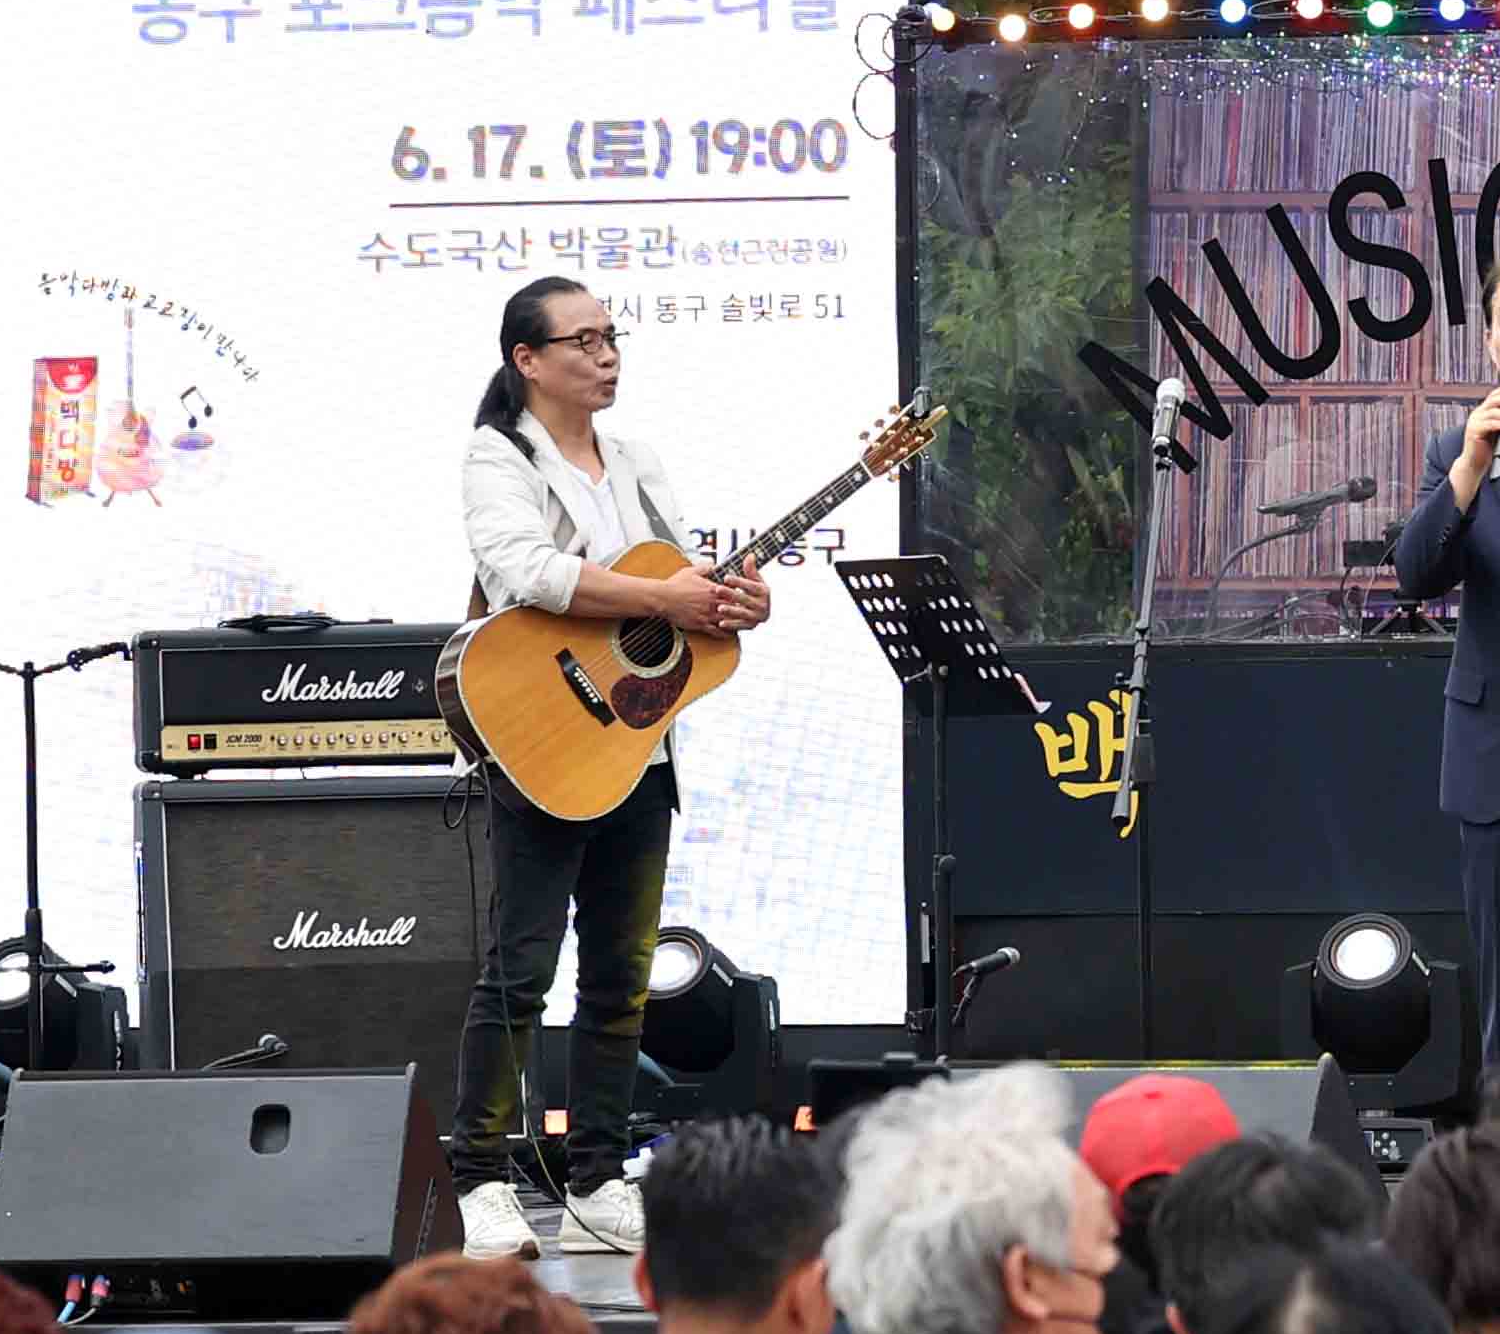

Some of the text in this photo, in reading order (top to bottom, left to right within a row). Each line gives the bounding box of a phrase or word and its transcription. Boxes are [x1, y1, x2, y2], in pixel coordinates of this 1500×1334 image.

[391, 117, 849, 183] 6. 17. (토) 19:00
[357, 226, 533, 273] 수도국산
[655, 296, 707, 324] 동구
[720, 294, 804, 323] 솔빛로
[813, 293, 846, 320] 51
[261, 663, 406, 703] Marshall
[1034, 689, 1140, 838] 백
[273, 910, 417, 950] Marshall
